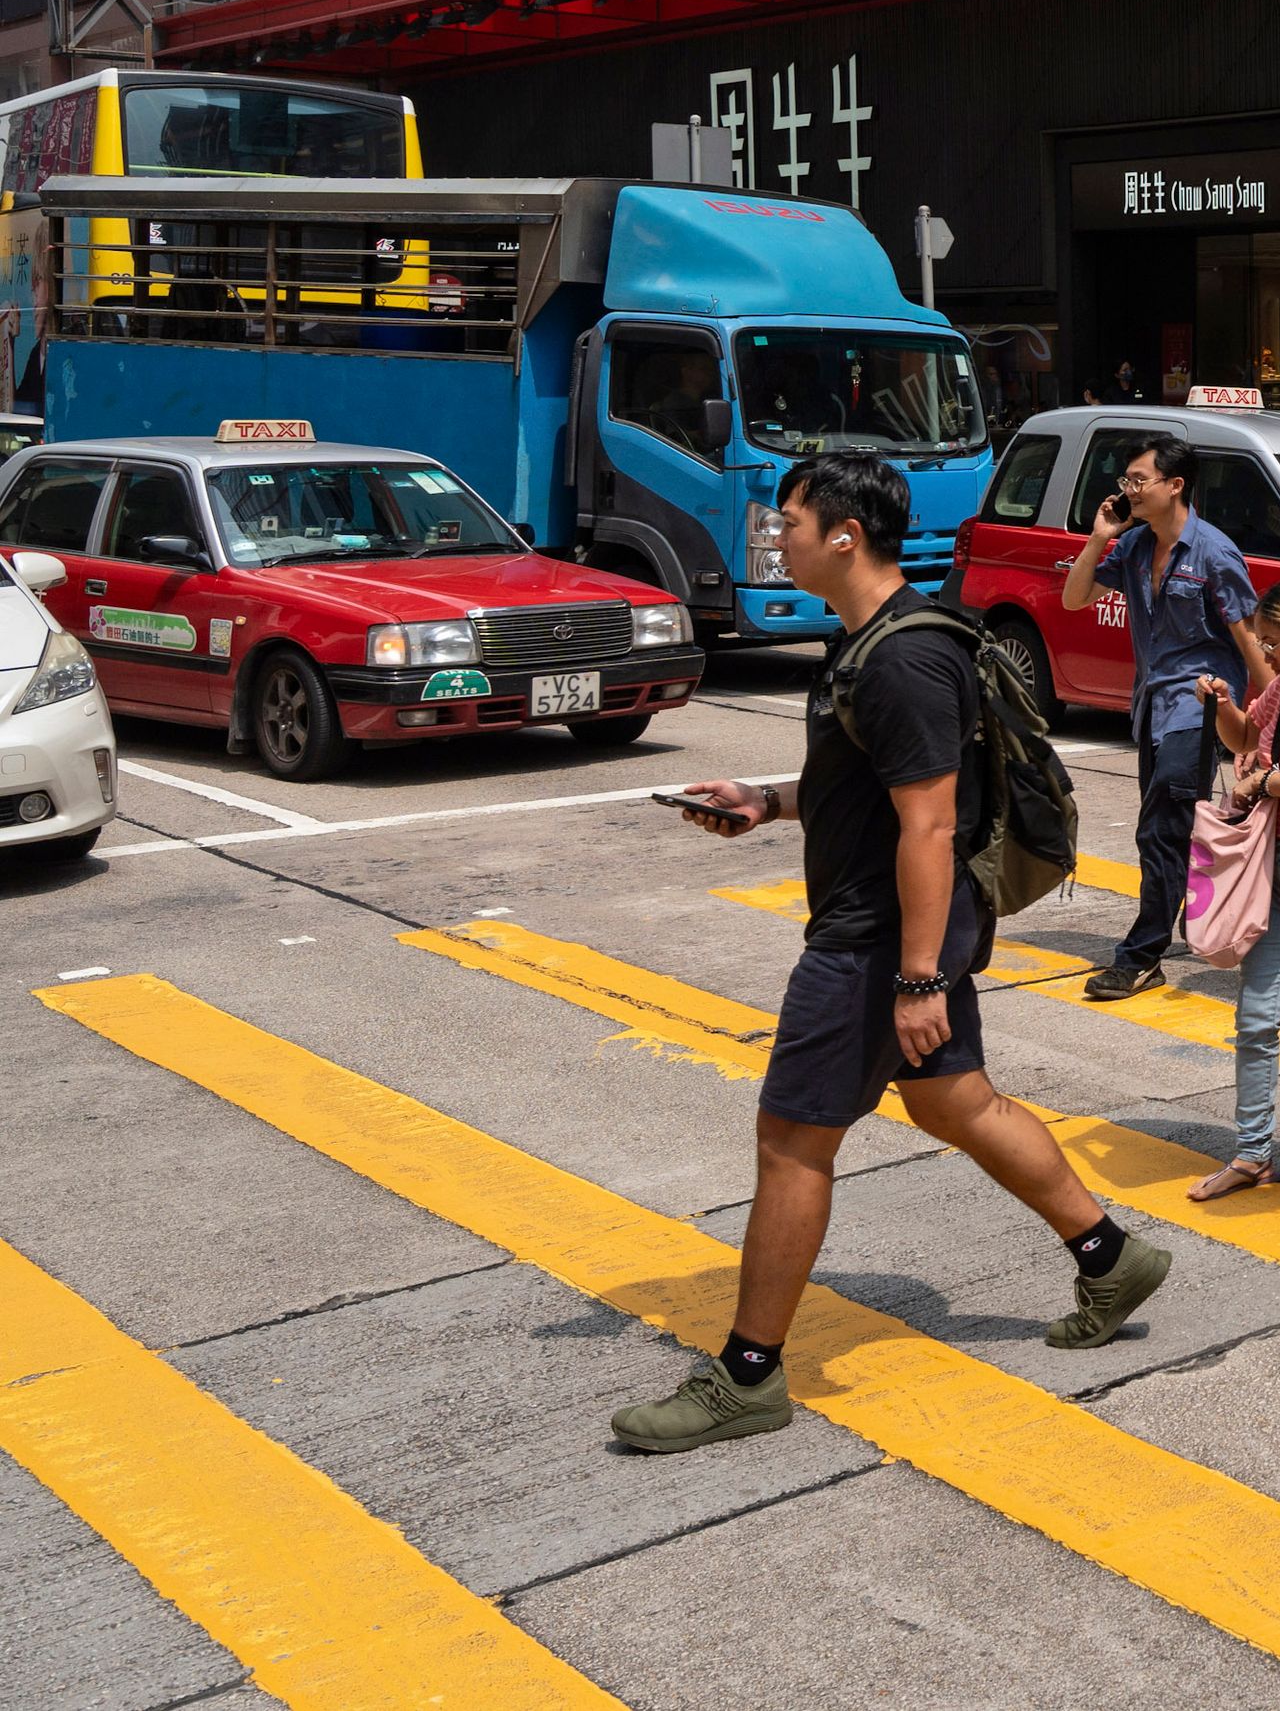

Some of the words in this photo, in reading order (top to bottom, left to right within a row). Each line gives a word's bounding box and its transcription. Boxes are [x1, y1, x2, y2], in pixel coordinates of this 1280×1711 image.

[1124, 170, 1166, 214] 周生生
[1171, 181, 1202, 211] Chow
[1205, 178, 1233, 214] Sang
[1236, 176, 1265, 213] Sang
[704, 199, 826, 222] ISUZU
[1203, 388, 1257, 405] TAXI
[234, 422, 306, 438] TAXI
[1096, 603, 1127, 628] TAXI
[450, 675, 464, 687] 4
[553, 674, 581, 694] VC
[436, 687, 478, 697] SEATS
[537, 691, 595, 715] 5724
